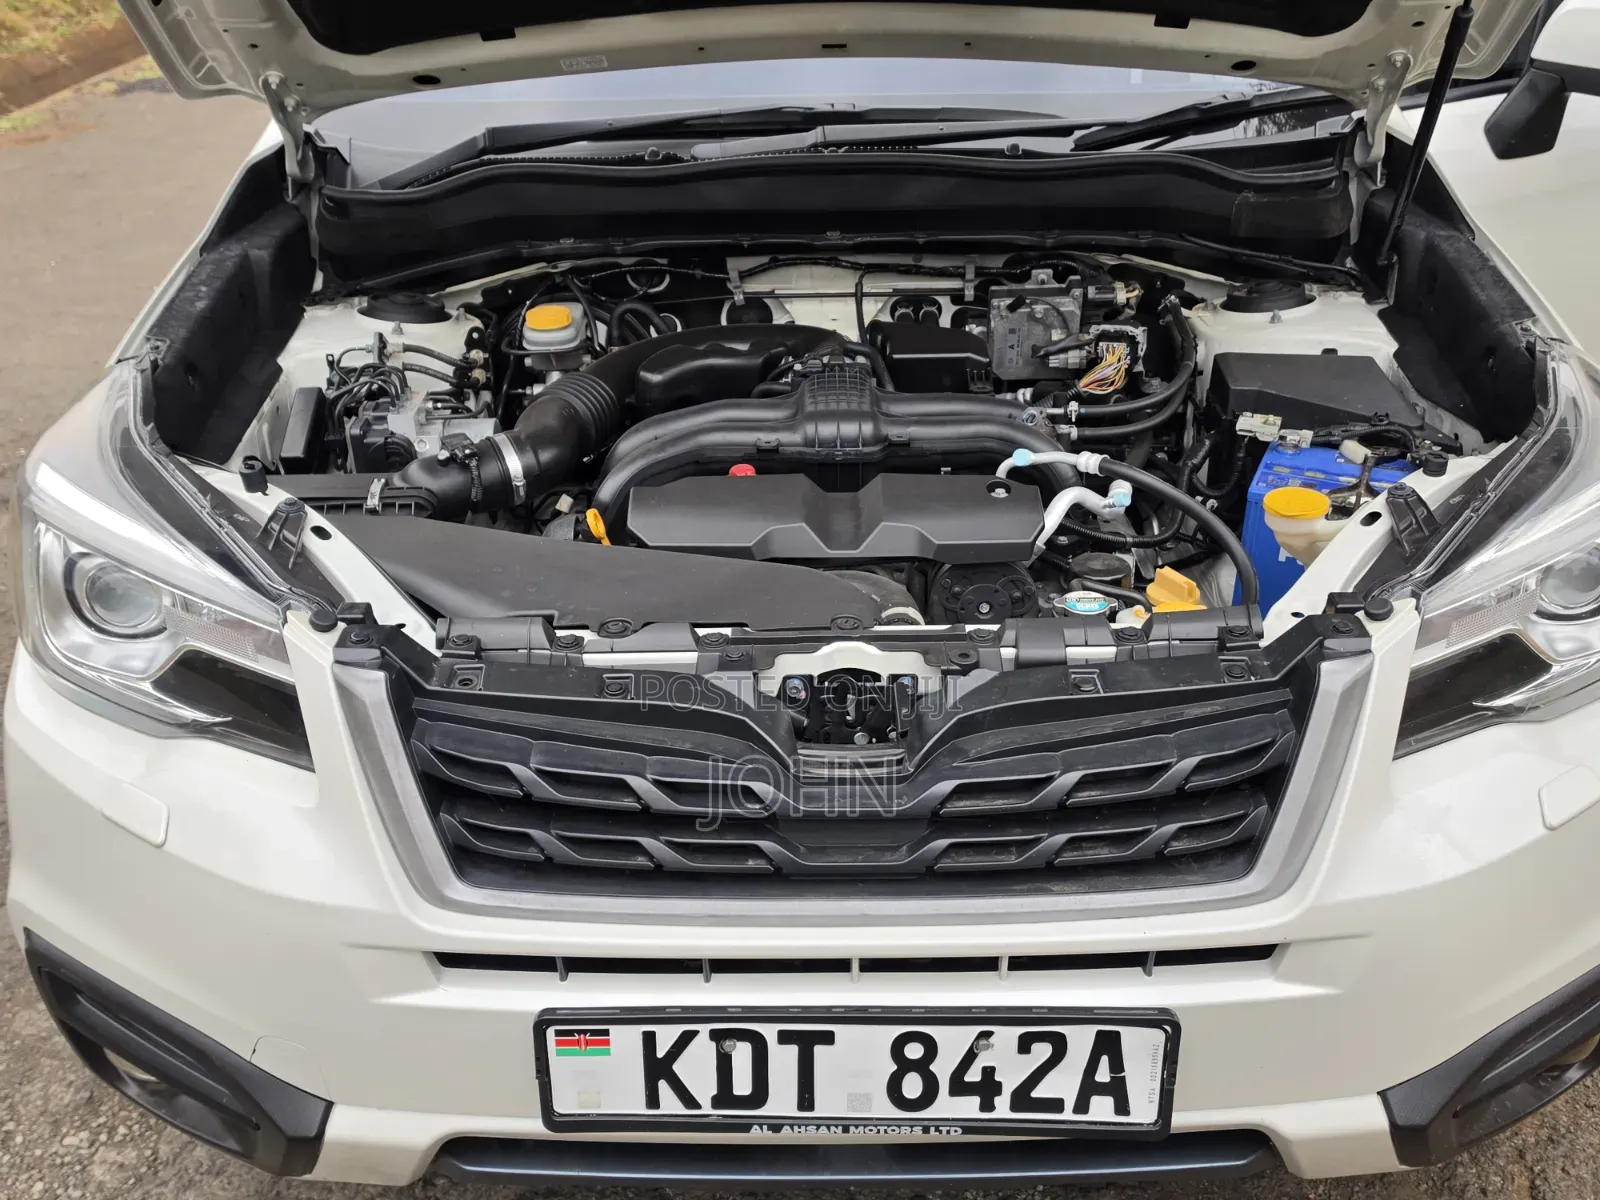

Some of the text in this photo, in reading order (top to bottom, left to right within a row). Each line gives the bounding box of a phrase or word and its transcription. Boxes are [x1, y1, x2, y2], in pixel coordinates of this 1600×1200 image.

[642, 1028, 1131, 1116] KDT 842A
[749, 1124, 963, 1136] AL AHSAN MOTORS LTD
